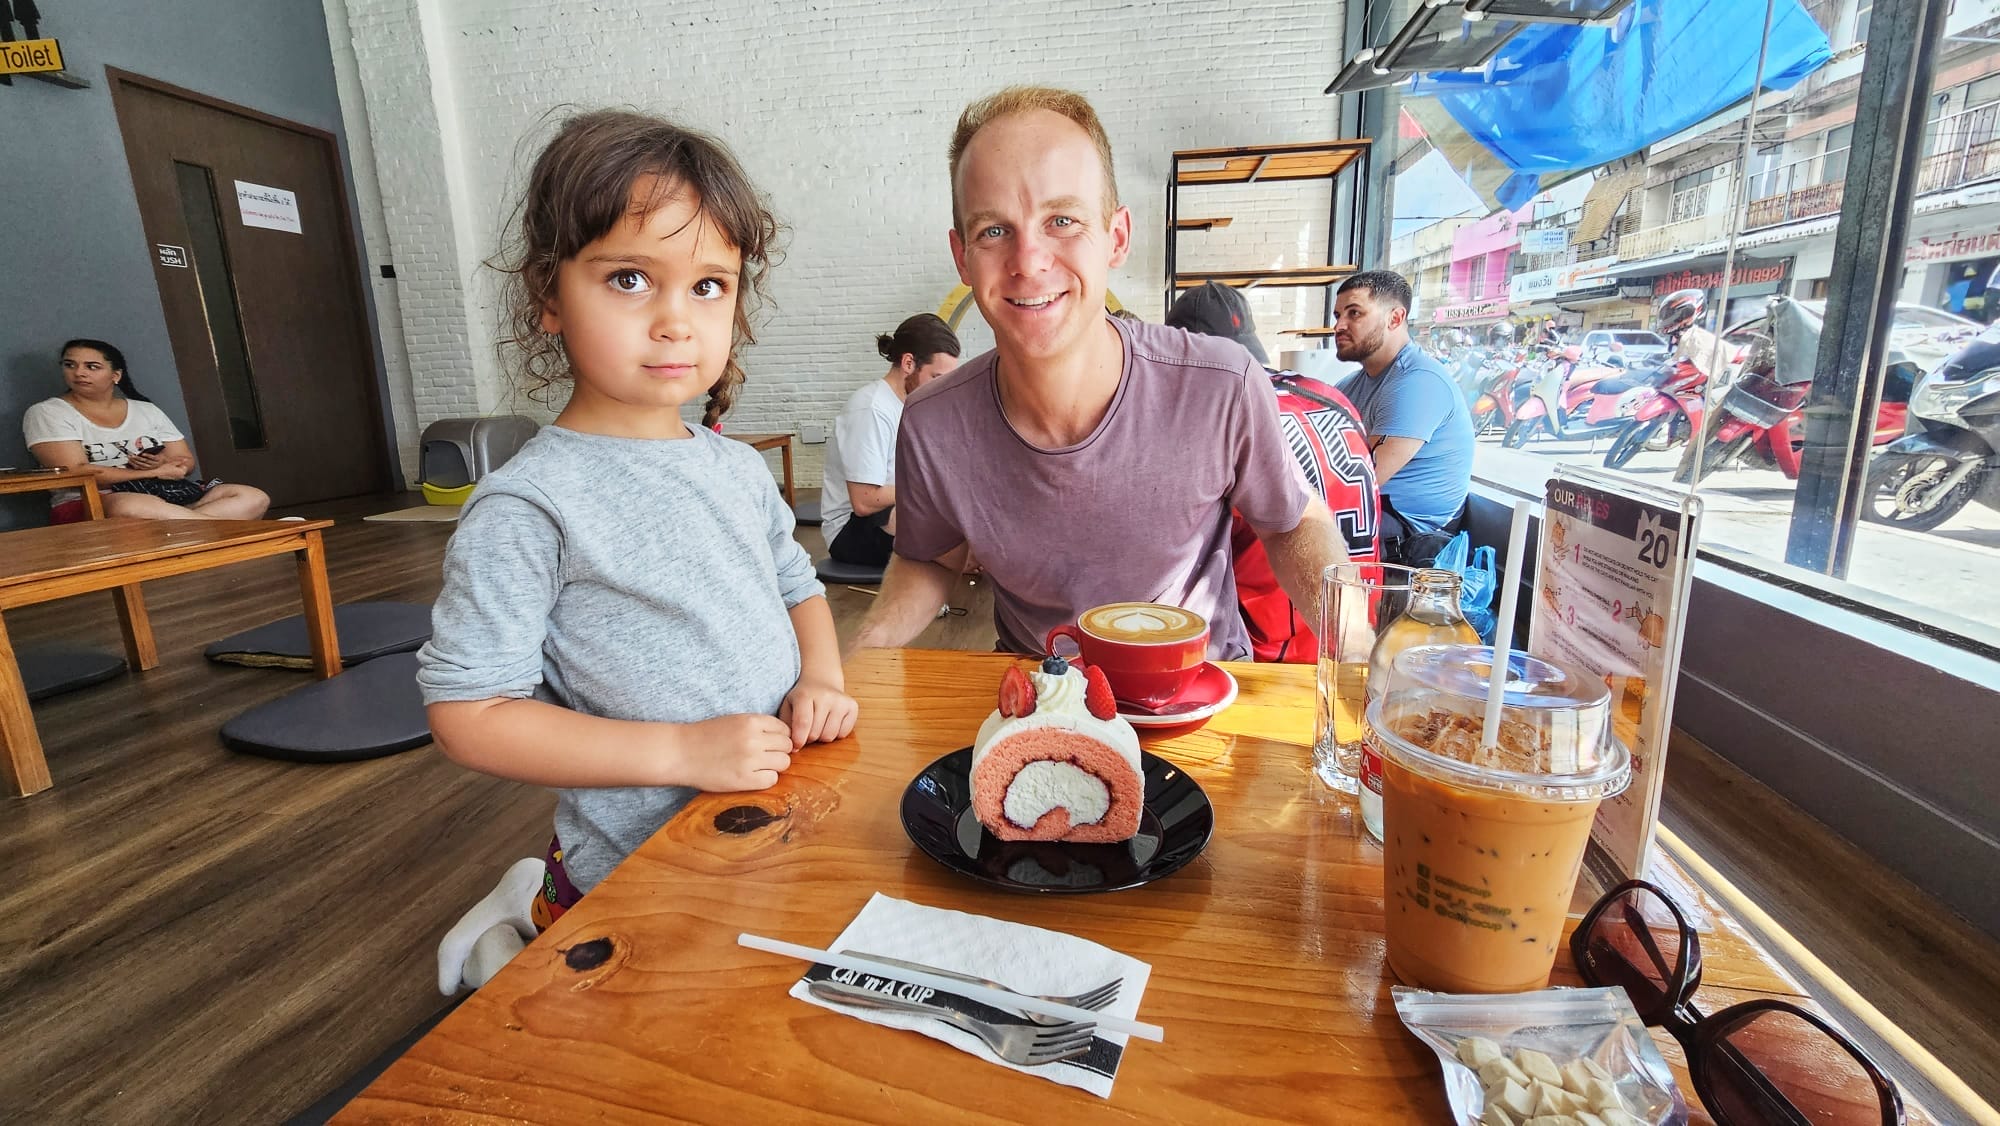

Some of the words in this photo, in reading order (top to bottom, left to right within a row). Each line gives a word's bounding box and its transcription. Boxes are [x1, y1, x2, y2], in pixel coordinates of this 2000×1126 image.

[0, 44, 54, 68] Toilet
[1554, 487, 1575, 508] OUR
[1574, 543, 1581, 564] 1
[1637, 529, 1670, 569] 20
[1567, 605, 1575, 625] 3
[1612, 599, 1622, 622] 2
[880, 980, 897, 997] A
[897, 983, 936, 1003] CUP
